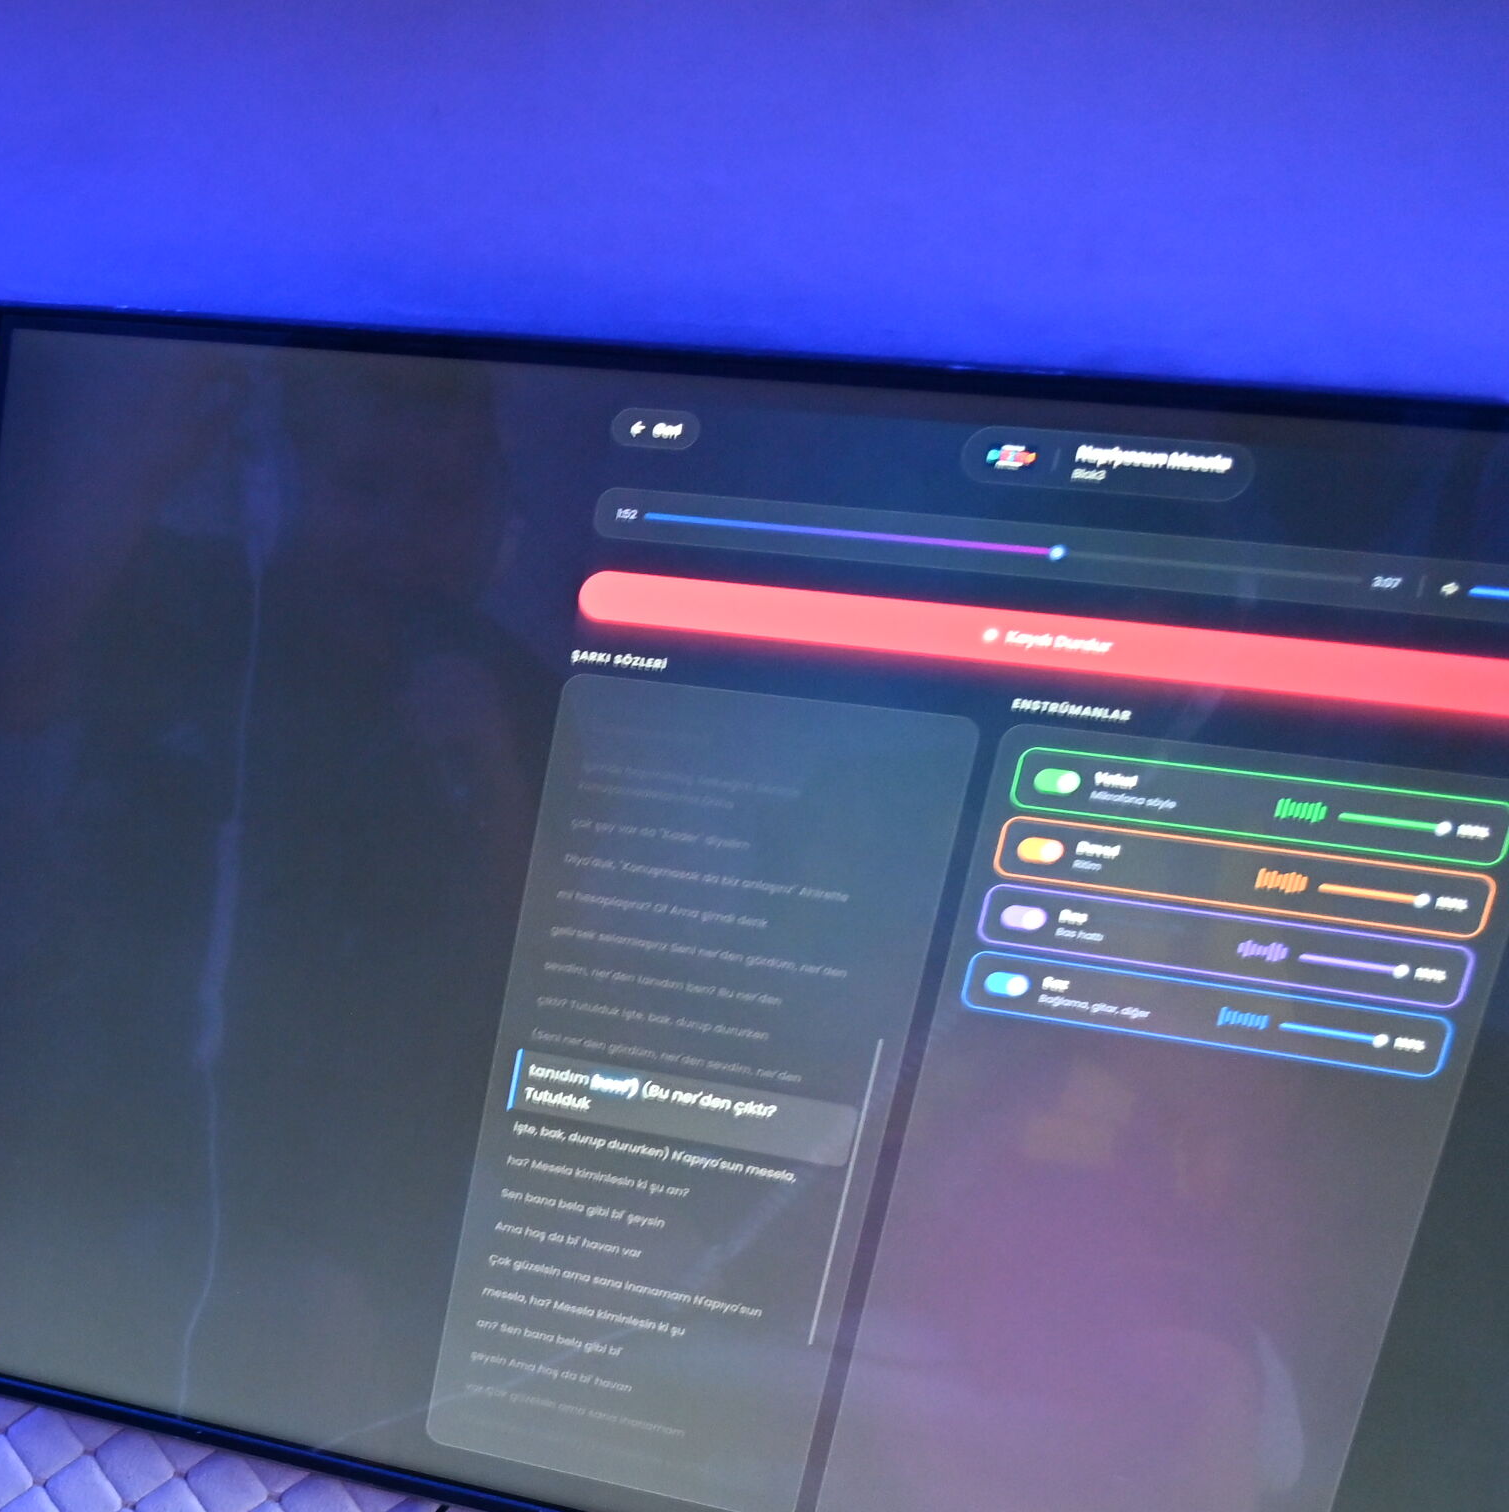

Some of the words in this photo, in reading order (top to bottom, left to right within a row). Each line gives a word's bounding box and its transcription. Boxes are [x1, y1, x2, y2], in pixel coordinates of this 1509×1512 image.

[571, 648, 611, 668] ŞARKI
[613, 652, 668, 672] SÖZLERİ
[1053, 634, 1114, 655] Durdur
[1011, 697, 1132, 723] ENSTRÜMANLAR
[1055, 926, 1075, 940] Bas
[1038, 994, 1089, 1011] Bağlama,
[524, 1087, 592, 1112] Tutulduk
[528, 1063, 590, 1086] tanıdım
[641, 1080, 670, 1101] (Bu
[671, 1087, 731, 1111] ner'den
[732, 1100, 778, 1119] çıktı?
[540, 1125, 566, 1142] bak,
[568, 1131, 606, 1151] durup
[606, 1138, 671, 1161] dururken)
[744, 1163, 798, 1185] mesela,
[506, 1155, 530, 1168] ha?
[531, 1159, 573, 1177] Mesela
[649, 1182, 665, 1196] şu
[666, 1185, 691, 1198] an?
[500, 1187, 523, 1201] Sen
[524, 1191, 557, 1207] bana
[557, 1198, 585, 1213] bela
[586, 1203, 610, 1219] gibi
[627, 1213, 666, 1230] şeysin
[495, 1221, 523, 1236] Ama
[523, 1225, 546, 1243] hoş
[547, 1232, 564, 1245] da
[582, 1237, 620, 1254] havan
[621, 1247, 642, 1259] var
[488, 1254, 512, 1268] Çok
[513, 1259, 561, 1278] güzelsin
[562, 1270, 591, 1284] ama
[592, 1274, 623, 1290] sana
[481, 1286, 528, 1304] mesela,
[529, 1294, 553, 1308] ha?
[553, 1300, 595, 1318] Mesela
[476, 1318, 499, 1332] an?
[500, 1324, 522, 1337] Sen
[523, 1328, 554, 1344] bana
[556, 1334, 582, 1350] bela
[583, 1340, 607, 1355] gibi
[509, 1358, 536, 1372] Ama
[561, 1369, 577, 1382] da
